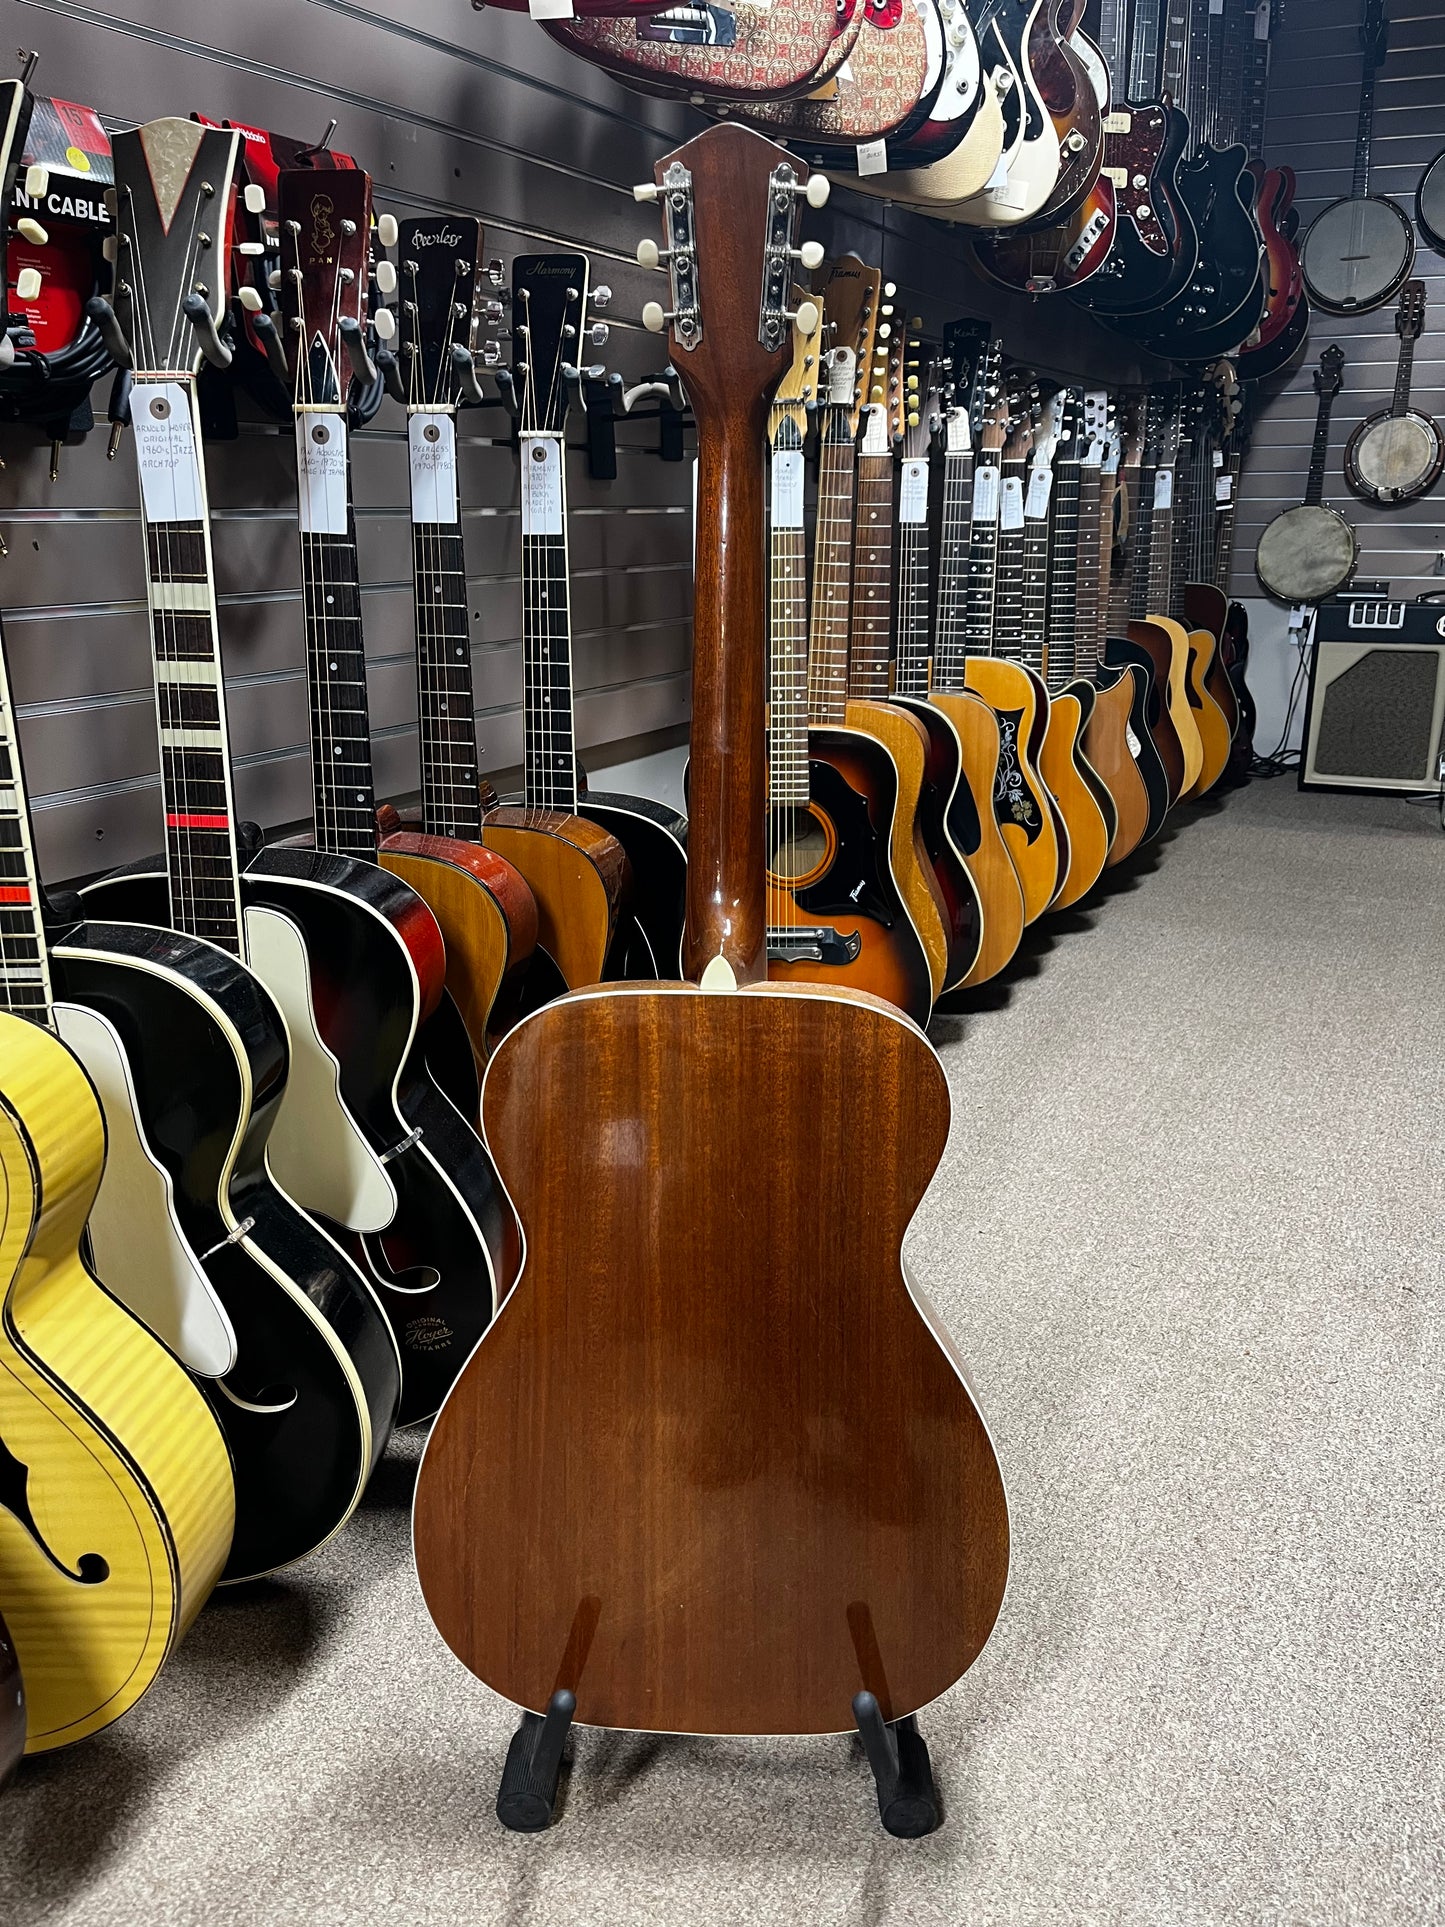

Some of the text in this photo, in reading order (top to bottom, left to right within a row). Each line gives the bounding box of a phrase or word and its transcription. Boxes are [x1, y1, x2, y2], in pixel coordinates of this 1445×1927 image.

[47, 193, 111, 223] CABLE
[412, 225, 462, 250] Peerless
[309, 256, 333, 264] PAN
[526, 261, 577, 279] Harmony
[828, 266, 861, 285] Framus
[953, 326, 979, 338] Kent
[136, 424, 166, 432] ARNOLD
[143, 435, 184, 443] ORIGINAL
[172, 444, 193, 455] JAZZ
[412, 445, 450, 453] PEERLESS
[142, 459, 180, 468] ARCHTOP
[406, 1317, 446, 1329] ORIGINAL
[405, 1327, 454, 1345] Hoyer
[412, 1339, 452, 1351] GITARRE
